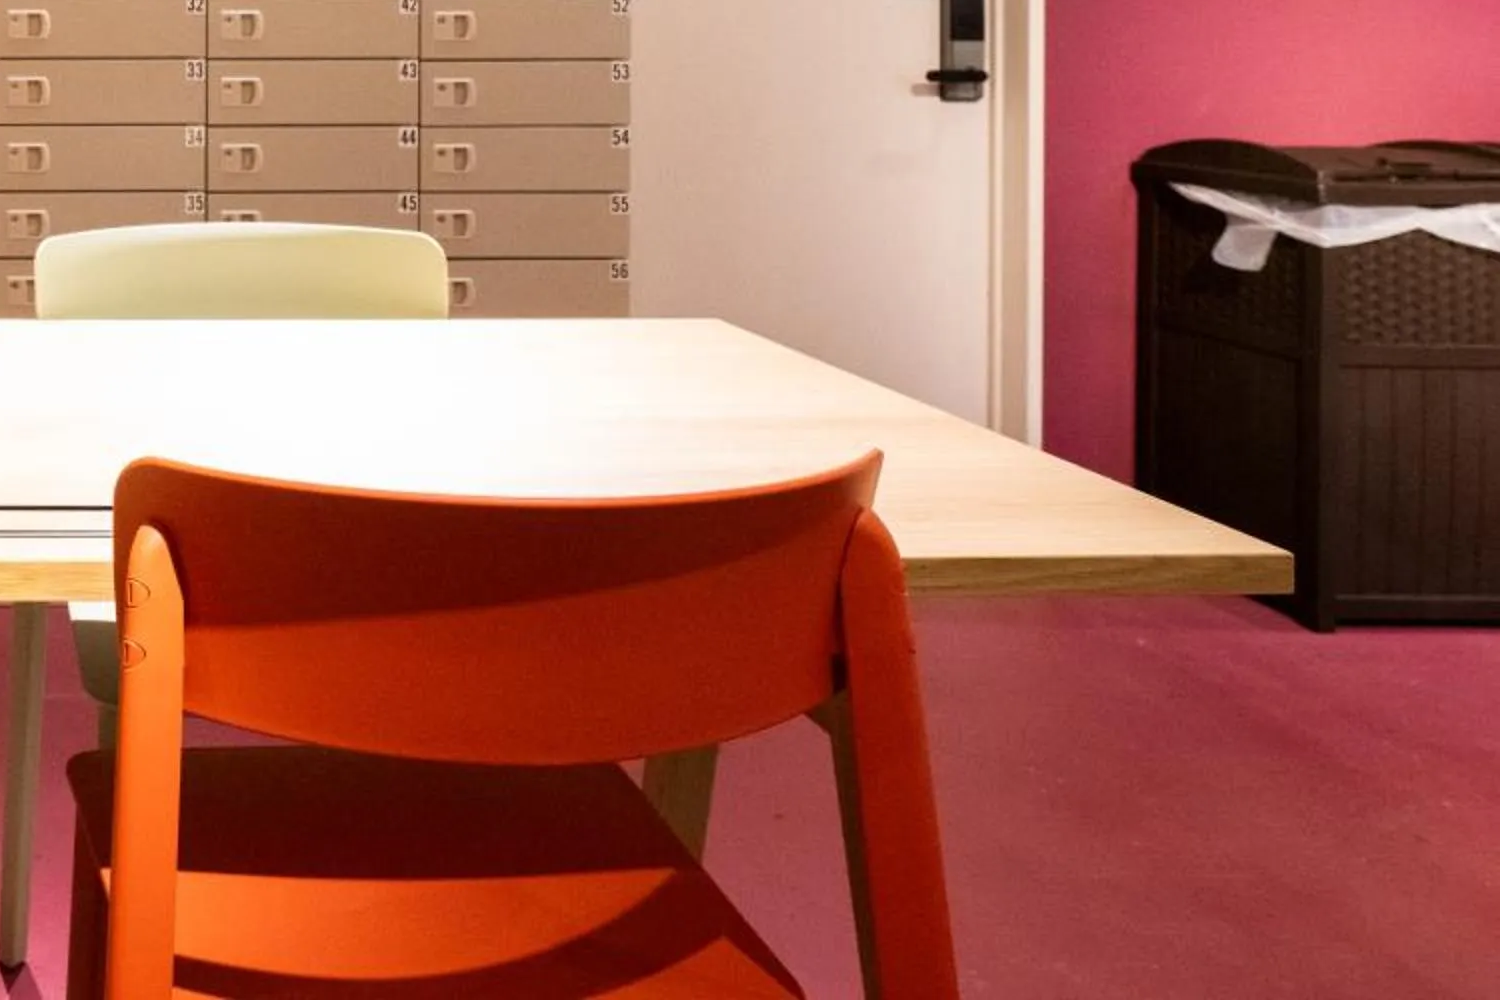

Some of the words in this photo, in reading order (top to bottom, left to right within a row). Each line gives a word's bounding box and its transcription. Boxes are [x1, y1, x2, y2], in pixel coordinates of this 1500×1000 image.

[187, 62, 203, 78] 33
[401, 63, 417, 78] 43
[612, 63, 630, 80] 53
[400, 129, 417, 145] 44
[612, 129, 629, 145] 54
[187, 195, 203, 211] 35
[401, 195, 417, 211] 45
[611, 196, 629, 213] 55
[611, 263, 629, 279] 56
